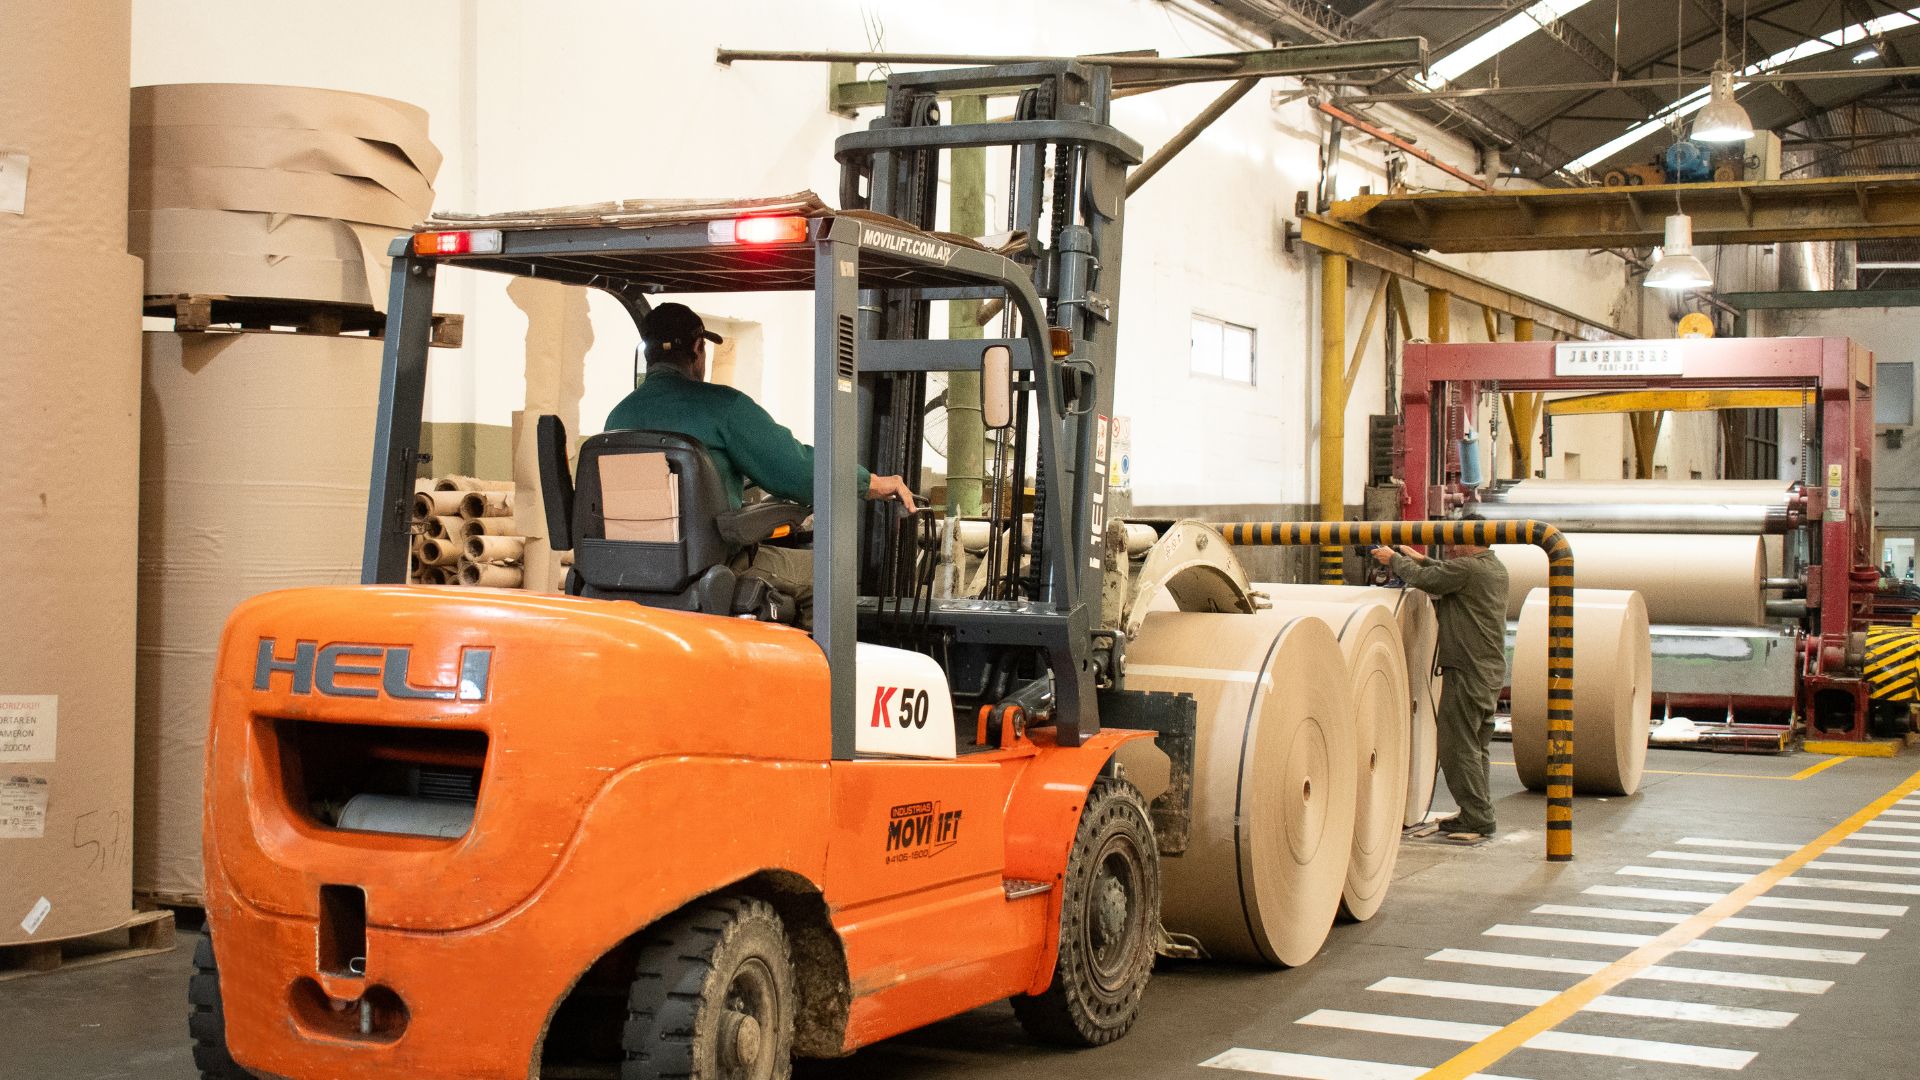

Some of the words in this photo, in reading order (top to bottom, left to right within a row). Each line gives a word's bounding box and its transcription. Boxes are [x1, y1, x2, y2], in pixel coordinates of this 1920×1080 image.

[863, 229, 951, 260] MOVILIFT.COM.AR
[253, 637, 495, 703] HELI
[871, 686, 898, 728] K
[899, 688, 929, 729] 50
